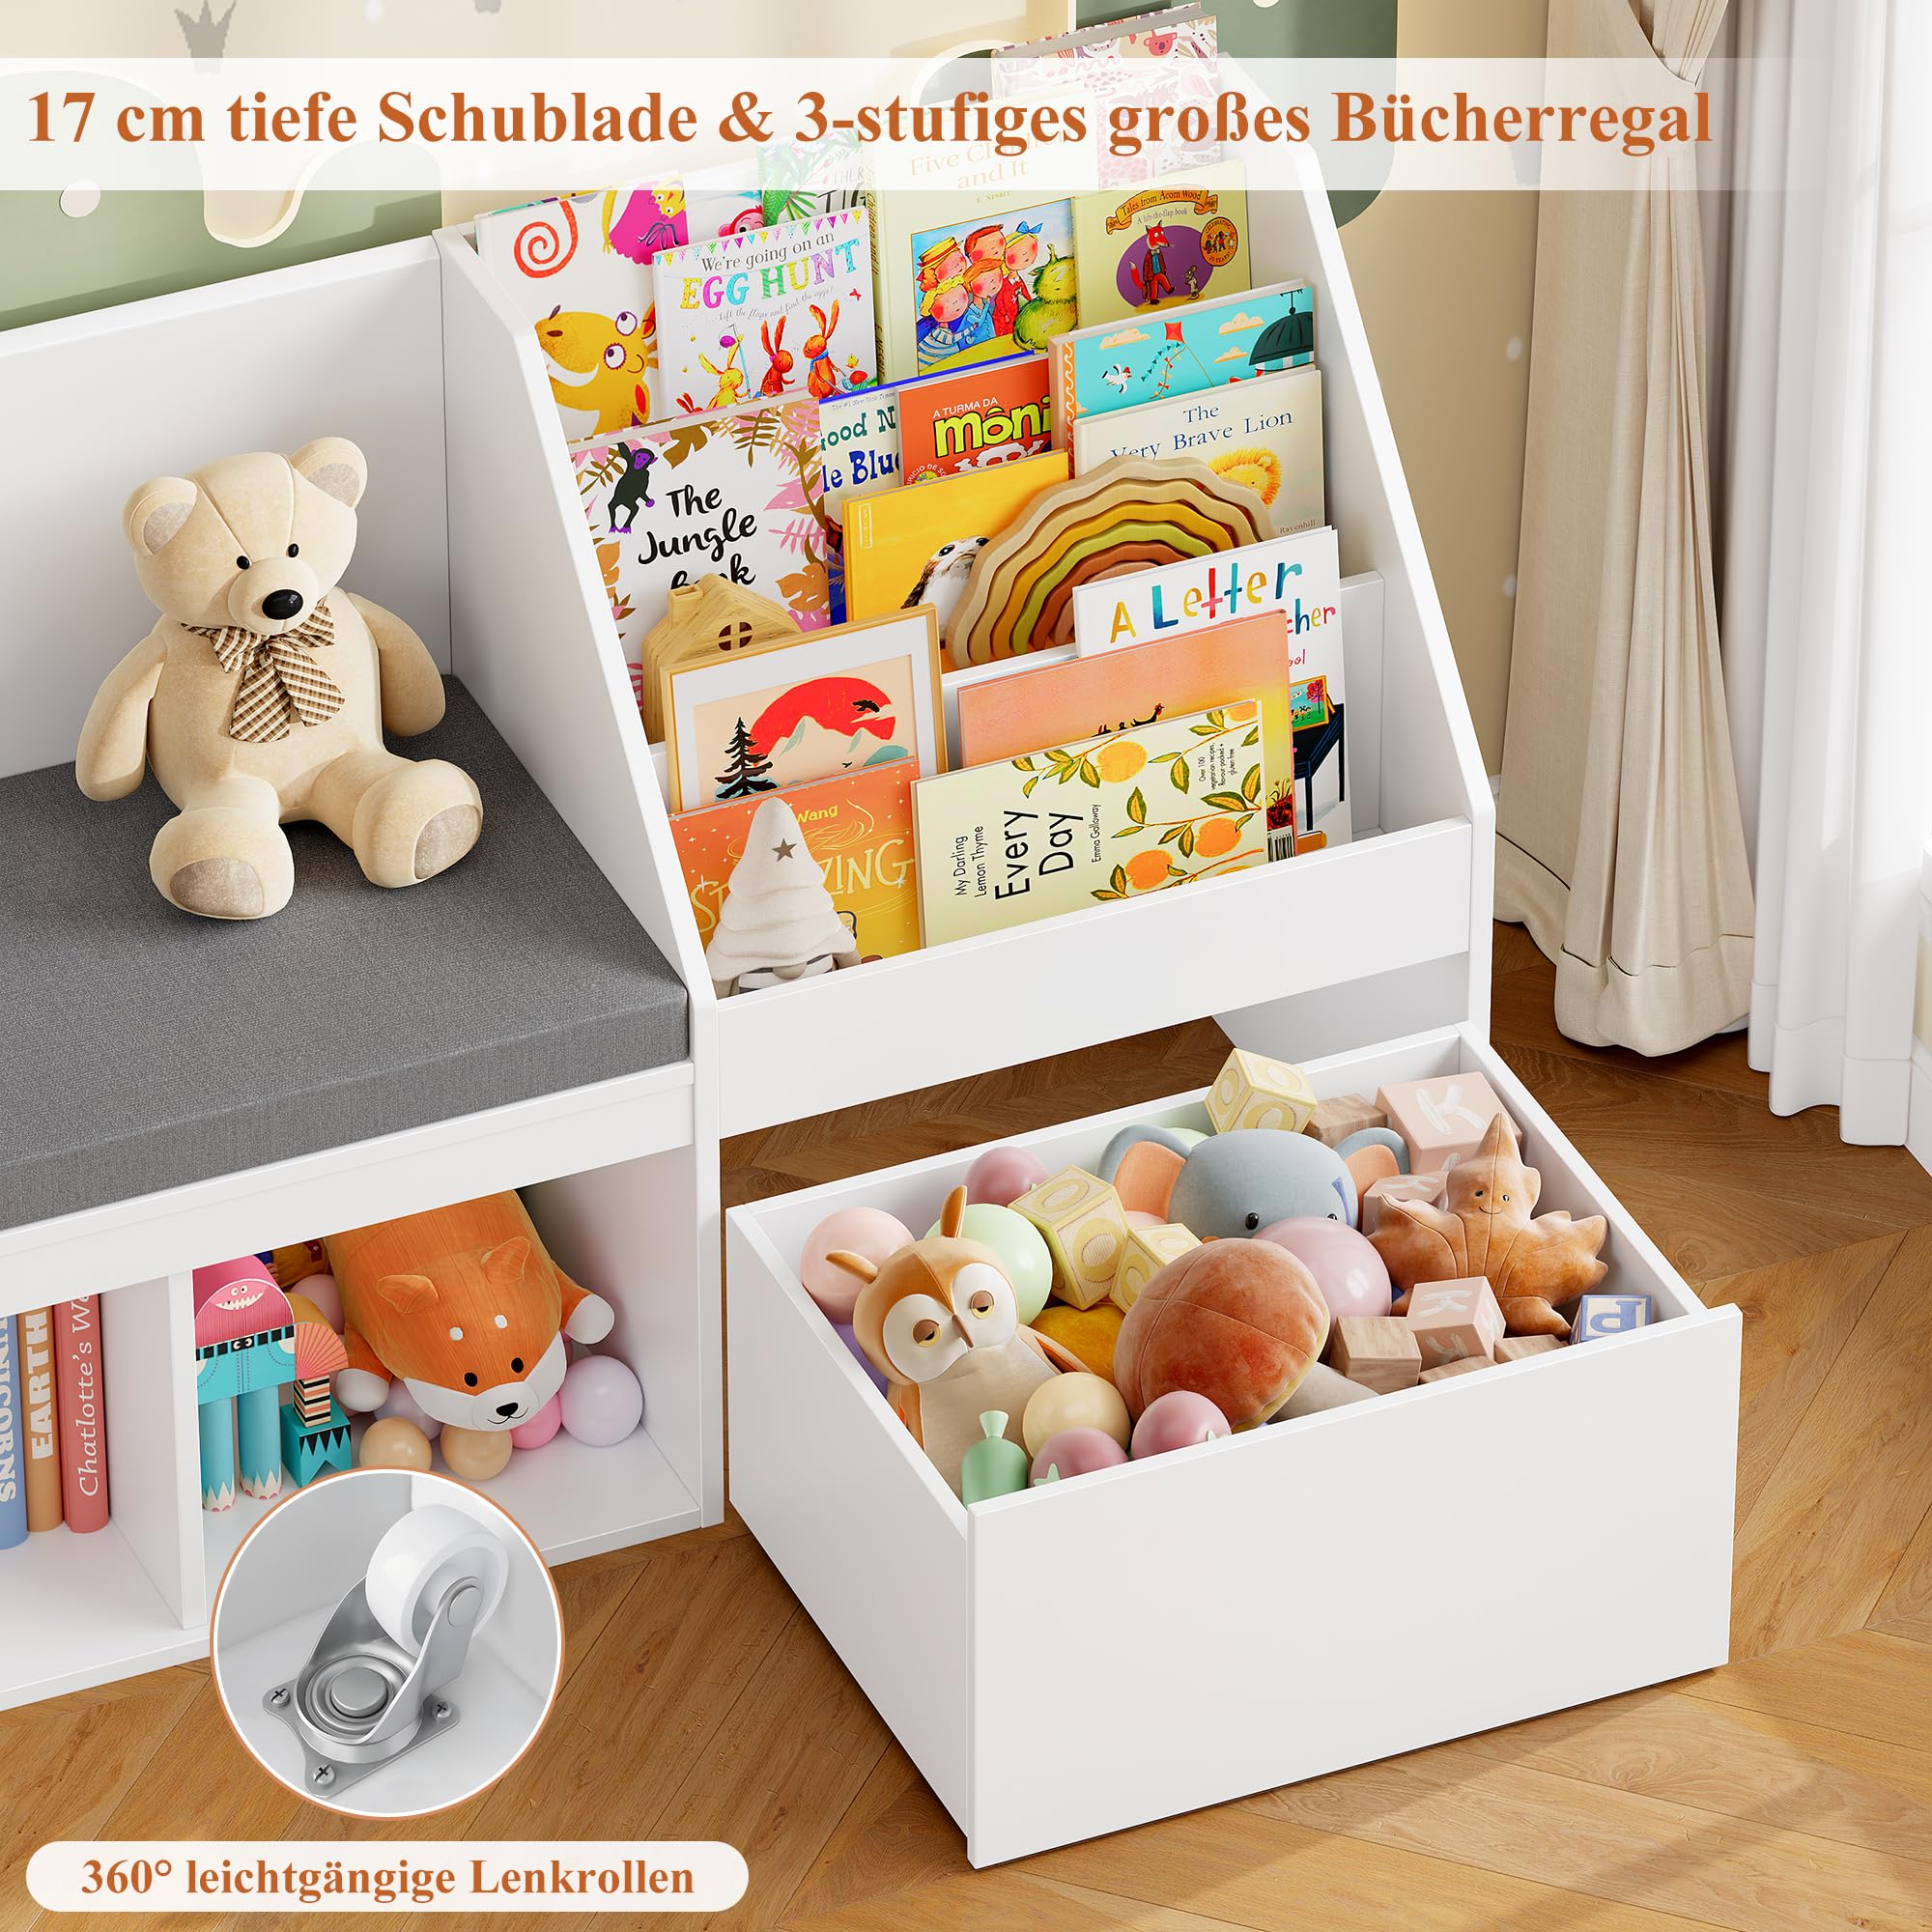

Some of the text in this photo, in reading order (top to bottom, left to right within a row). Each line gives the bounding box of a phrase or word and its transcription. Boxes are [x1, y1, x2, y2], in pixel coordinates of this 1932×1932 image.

[1121, 202, 1139, 216] Tales
[1140, 193, 1157, 207] from
[1159, 189, 1180, 201] Acorn
[1175, 207, 1188, 216] book
[679, 238, 861, 310] EGG HUNT
[700, 231, 835, 272] We're going on an
[932, 396, 999, 419] A TURMA DA
[1173, 425, 1234, 452] Brave
[1243, 410, 1293, 435] Lion
[1182, 404, 1220, 424] The
[665, 483, 723, 518] The
[637, 507, 758, 565] Jungle
[1279, 519, 1317, 535] Ravenhill
[669, 553, 756, 591] Bk
[1109, 560, 1303, 643] A Letter
[795, 804, 838, 825] Wang
[1088, 804, 1102, 864] Emma Galloway
[950, 835, 971, 896] My Darling
[970, 825, 989, 898] Lemon Thyme
[994, 810, 1039, 900] Every
[1038, 812, 1084, 876] Day
[1414, 1084, 1488, 1135] K
[25, 1310, 54, 1461] EARTH
[72, 1341, 99, 1497] Chatlotte's
